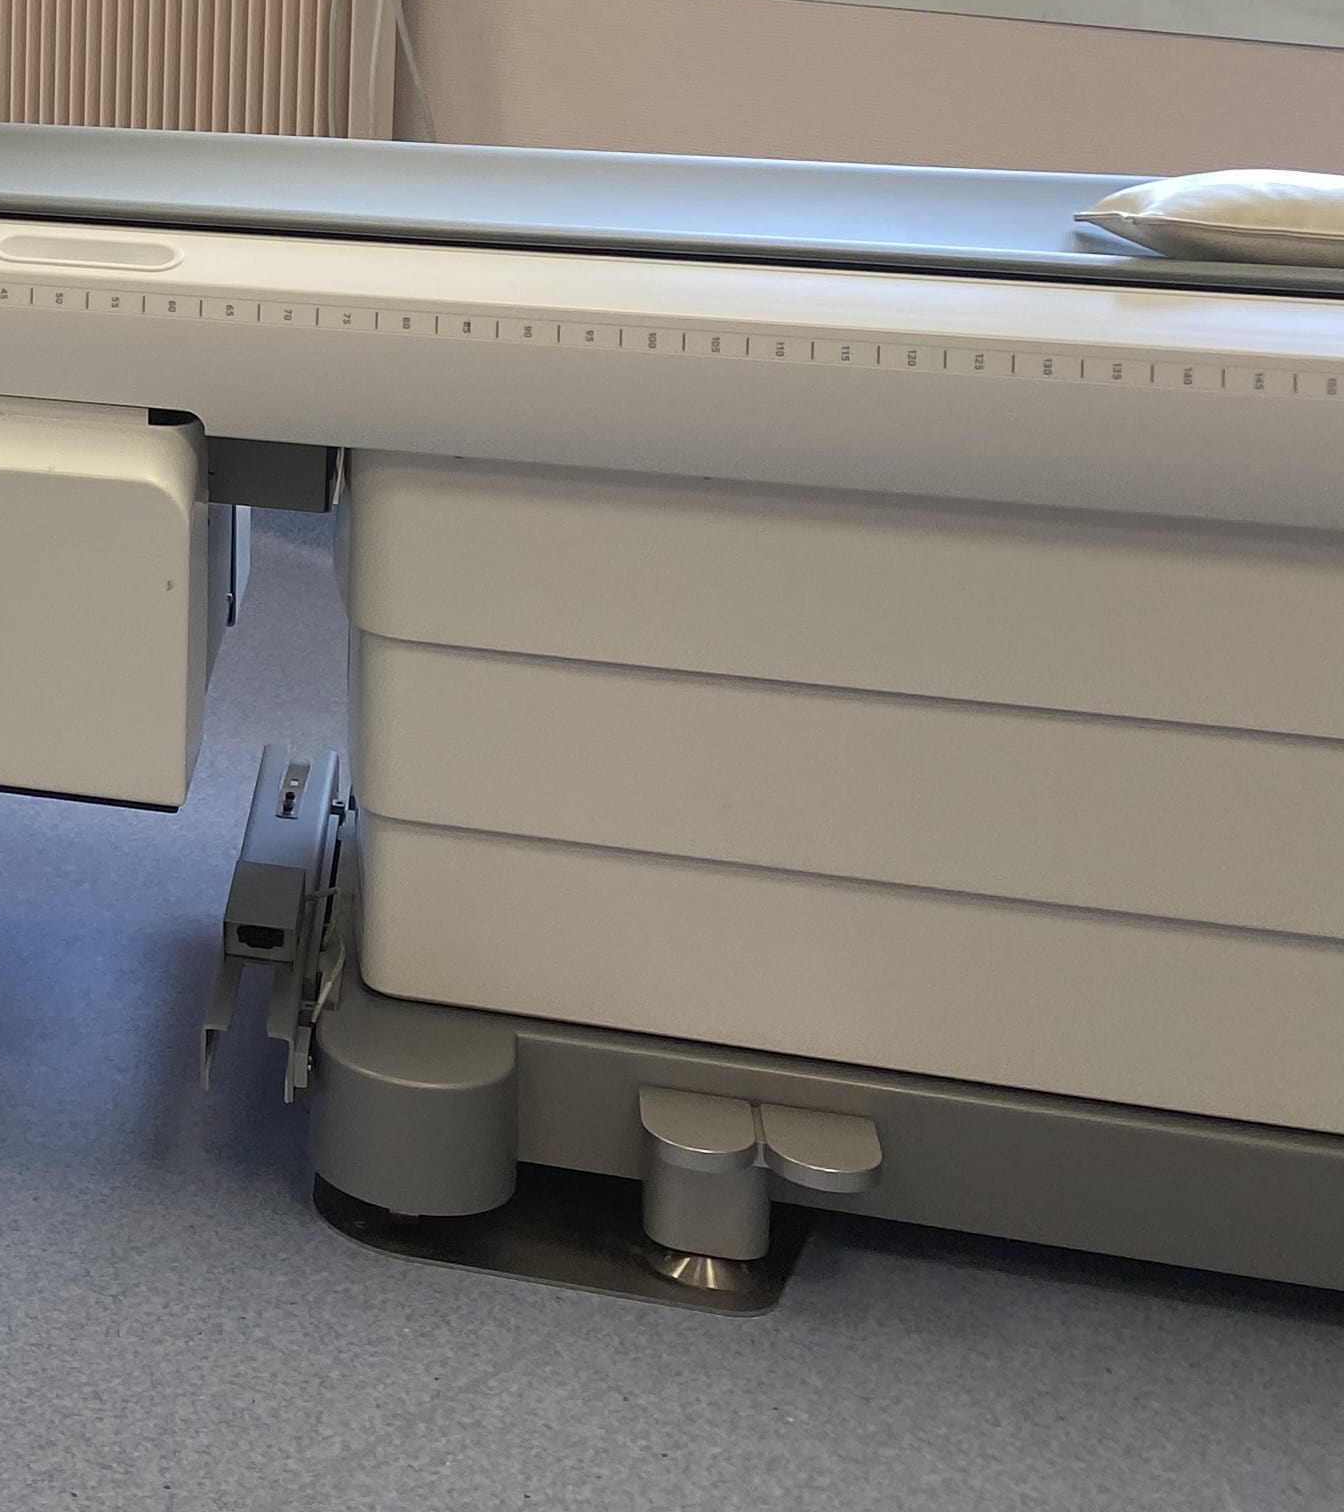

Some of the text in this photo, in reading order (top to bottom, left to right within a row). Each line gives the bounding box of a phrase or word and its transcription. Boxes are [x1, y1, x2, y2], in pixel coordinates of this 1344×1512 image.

[0, 287, 9, 300] 45
[55, 292, 65, 305] 50
[111, 296, 120, 309] 55
[225, 304, 235, 317] 65
[283, 309, 293, 321] 70
[342, 312, 352, 325] 75
[523, 325, 533, 339] 90
[584, 329, 595, 343] 95
[647, 332, 657, 350] 100
[710, 336, 721, 353] 105
[775, 341, 785, 358] 110
[840, 345, 851, 362] 115
[907, 349, 918, 367] 120
[973, 353, 985, 371] 125
[1042, 358, 1053, 376] 130
[1183, 367, 1193, 386] 140
